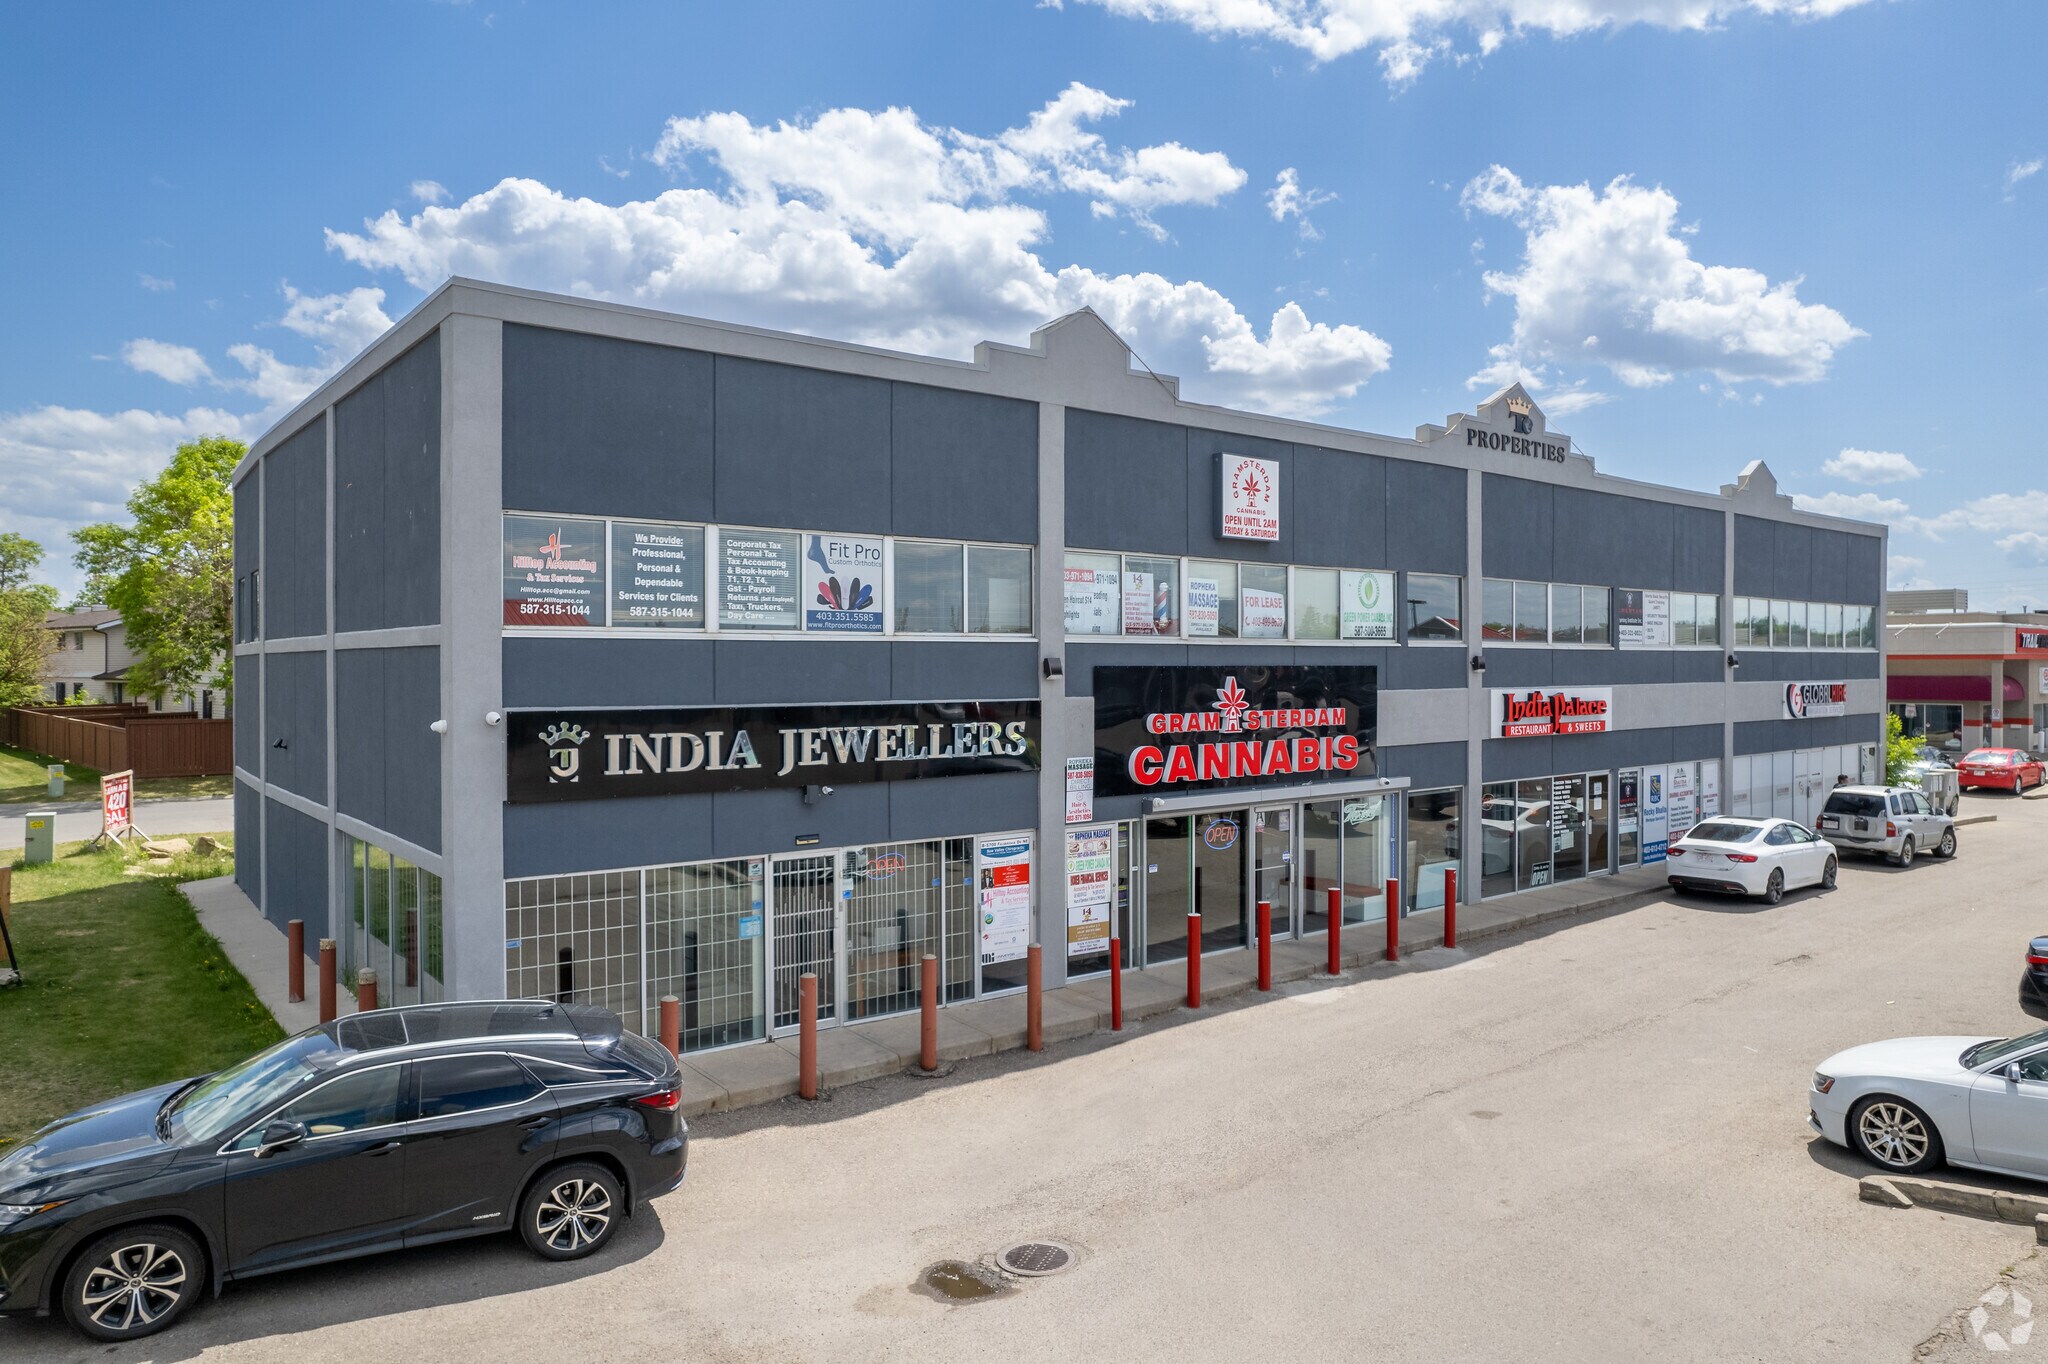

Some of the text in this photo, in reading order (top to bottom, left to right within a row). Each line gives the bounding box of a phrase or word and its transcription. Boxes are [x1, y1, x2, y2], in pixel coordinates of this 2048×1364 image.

[1467, 428, 1566, 463] PROPERTIES
[1232, 460, 1271, 503] GRAMSTERDAM
[1236, 507, 1266, 516] CANNABIS
[1224, 514, 1277, 529] OPEN UNTIL 2AM
[1224, 526, 1277, 539] FRIDAY & SATURDAY
[634, 533, 683, 545] We Provide:
[726, 539, 782, 549] Corporate Tax
[632, 547, 686, 561] Professional,
[726, 548, 777, 558] Personal Tax
[829, 542, 881, 560] Fit Pro
[512, 555, 597, 573] Hilltop Accounting
[636, 562, 681, 573] Personal &
[726, 557, 786, 568] Tax Accounting
[828, 557, 882, 567] Custom Orthotics
[726, 566, 789, 577] & Book-keeping
[526, 572, 584, 583] & Tax Services
[634, 577, 683, 588] Dependable
[726, 575, 768, 585] T1, T2, T4,
[726, 584, 742, 592] Gst
[748, 585, 776, 594] Payroll
[1190, 581, 1216, 591] ROPHEKA
[618, 591, 698, 602] Services for Clients
[727, 593, 759, 601] Returns
[1188, 592, 1218, 608] MASSAGE
[1244, 596, 1283, 608] FOR LEASE
[520, 604, 590, 615] 587-315-1044
[629, 606, 694, 617] 587-315-1044
[747, 603, 784, 611] Truckers,
[727, 611, 743, 620] Day
[745, 611, 764, 619] Care
[815, 612, 874, 622] 403.351.5585
[807, 621, 882, 630] www.fitproorthotics.com
[2021, 632, 2039, 648] TRAIL
[1801, 684, 1847, 703] GLOBAL HIRE
[1502, 691, 1607, 733] India Palace
[1510, 722, 1601, 735] RESTAURANT & SWEETS
[604, 720, 1026, 777] INDIA JEWELLERS
[1128, 735, 1359, 786] CANNABIS
[107, 791, 127, 810] 420
[105, 807, 129, 825] SALE
[1644, 808, 1655, 816] Rocky
[1074, 830, 1110, 840] ROPHEKA MASSAGE
[1206, 827, 1236, 843] OPEN
[867, 857, 905, 875] OPEN
[1531, 869, 1549, 885] OPEN
